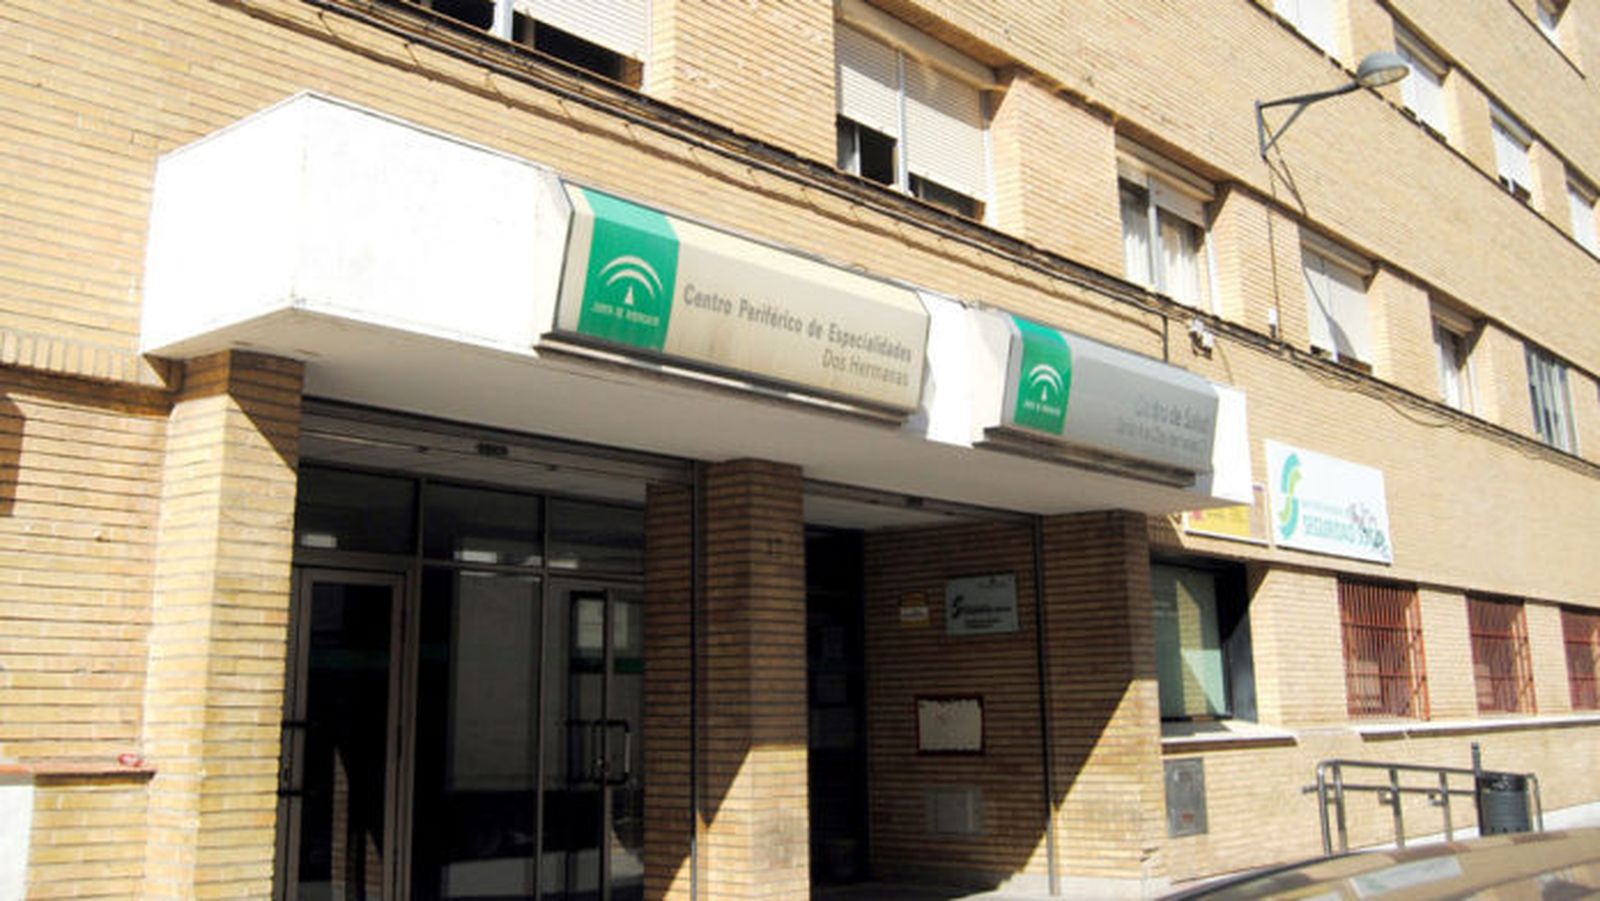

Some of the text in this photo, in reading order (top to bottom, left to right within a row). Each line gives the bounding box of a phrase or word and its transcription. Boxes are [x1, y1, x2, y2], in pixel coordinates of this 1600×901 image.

[683, 284, 912, 363] Centro Periférico de Especialidades
[822, 349, 909, 387] Dos Hermanas
